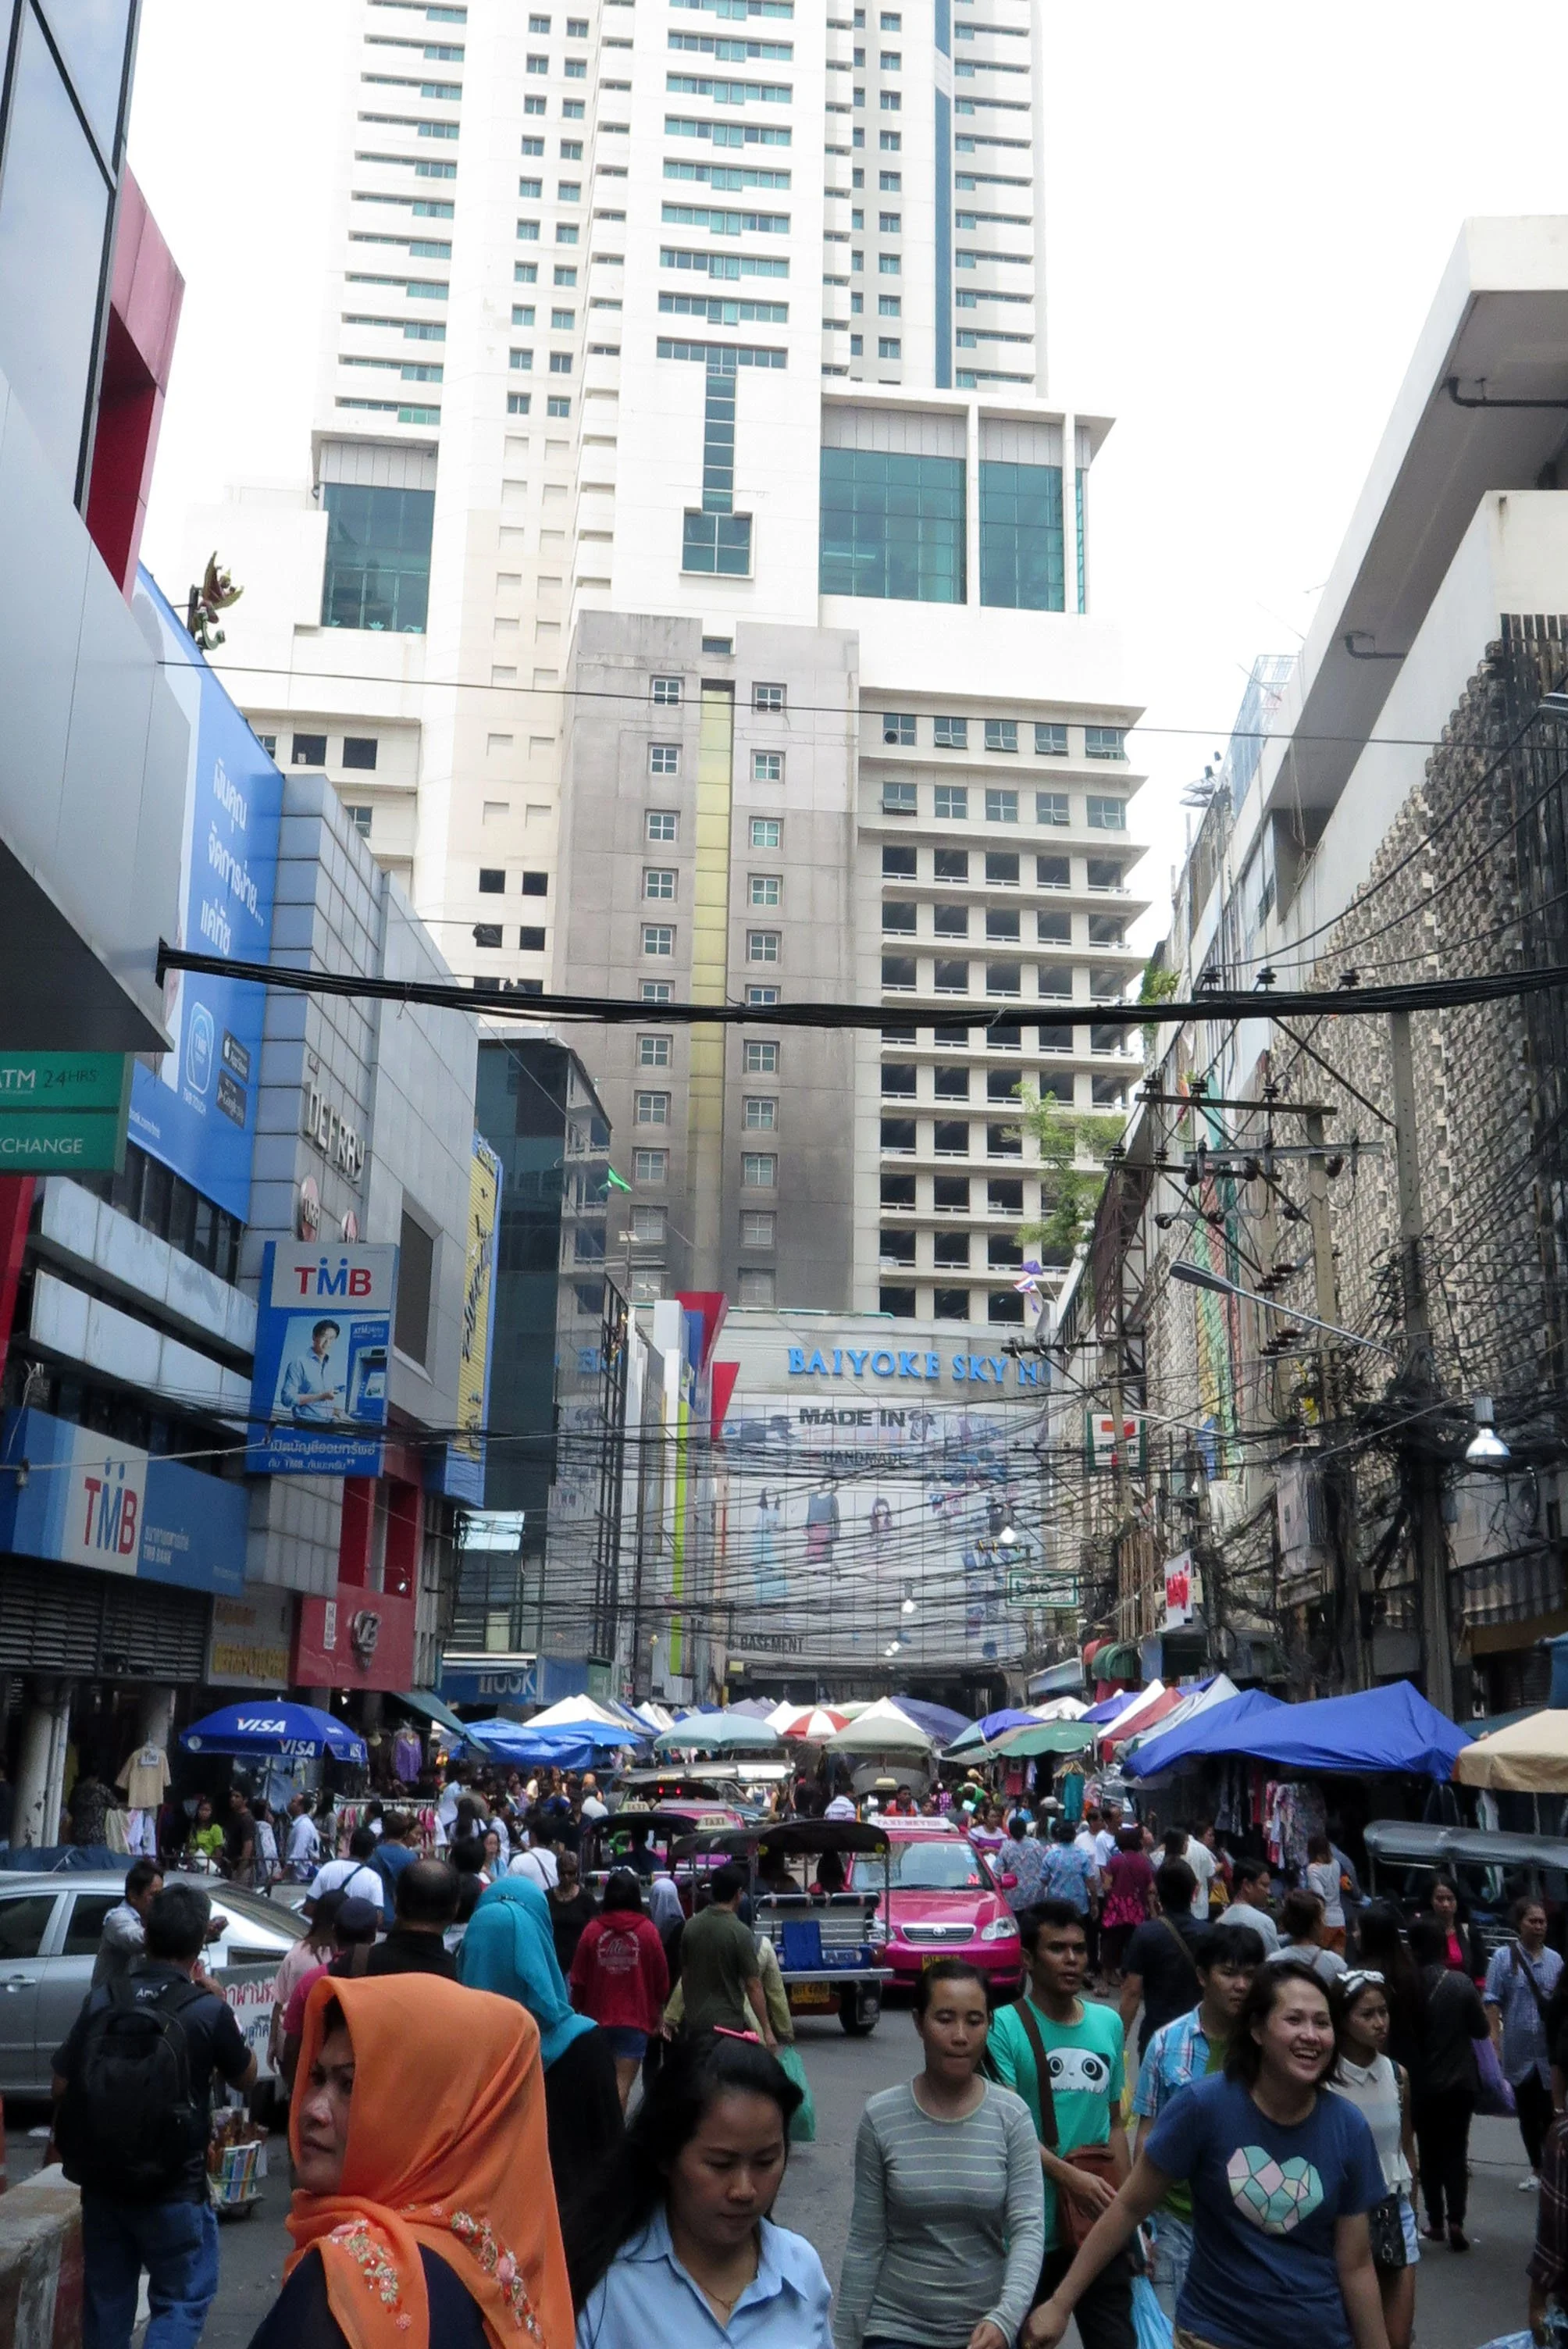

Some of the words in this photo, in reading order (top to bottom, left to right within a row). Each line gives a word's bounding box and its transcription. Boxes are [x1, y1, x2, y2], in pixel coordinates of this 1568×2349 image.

[0, 1069, 36, 1089] TM
[0, 1138, 84, 1153] CHANGE
[294, 1257, 372, 1297] TMB
[788, 1346, 941, 1380] BAIYOKE
[952, 1353, 1008, 1383] SKY
[799, 1408, 872, 1427] MADE
[880, 1409, 906, 1428] IN
[84, 1457, 138, 1556] TMB
[237, 1717, 287, 1734] VISA
[279, 1738, 315, 1757] VISA
[704, 1816, 725, 1827] TAXI
